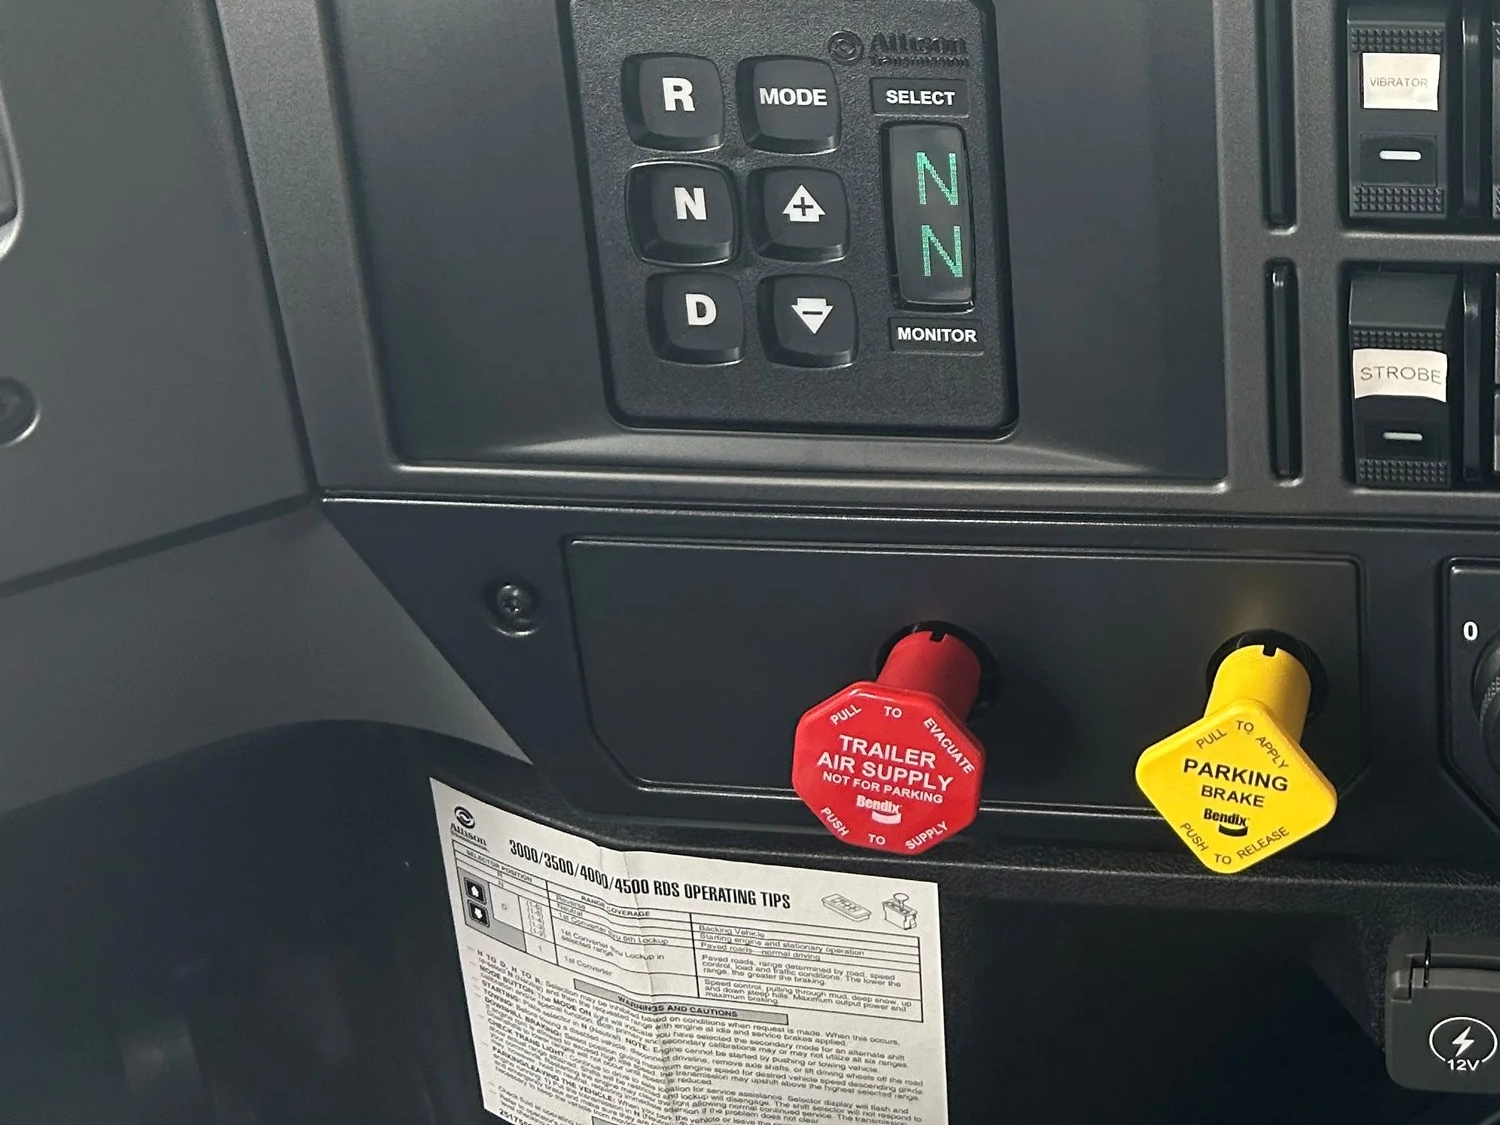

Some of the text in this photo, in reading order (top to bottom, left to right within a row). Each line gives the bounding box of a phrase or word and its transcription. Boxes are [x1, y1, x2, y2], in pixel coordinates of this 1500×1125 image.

[662, 77, 695, 112] R
[759, 87, 827, 106] MODE
[886, 89, 955, 105] SELECT
[1370, 77, 1428, 88] VIBRATOR
[916, 151, 958, 206] N
[674, 186, 708, 220] N
[921, 225, 963, 277] N
[685, 293, 717, 326] D
[897, 326, 977, 343] MONITOR
[1360, 366, 1442, 385] STROBE
[1463, 622, 1478, 641] 0
[830, 705, 976, 774] PULL TO EVACUATE
[839, 734, 936, 768] TRAILER
[1196, 720, 1289, 770] PULL TO APPLY
[817, 752, 954, 792] AIR SUPPLY
[823, 771, 943, 804] NOT FOR PARKING
[1183, 758, 1289, 792] PARKING
[856, 795, 900, 814] Bendix
[1200, 785, 1265, 807] BRAKE
[820, 807, 949, 850] PUSH TO SUPPLY
[1203, 808, 1247, 826] Bendix
[1180, 822, 1290, 865] PUSH TO RELEASE
[509, 839, 649, 895] 3000/3500/4000/4500
[654, 881, 680, 897] RDS
[684, 883, 756, 905] OPERATING
[760, 892, 791, 909] TIPS
[702, 954, 728, 962] Paved
[667, 1005, 687, 1013] AND
[690, 1007, 738, 1017] CAUTIONS
[1448, 1059, 1479, 1071] 12V
